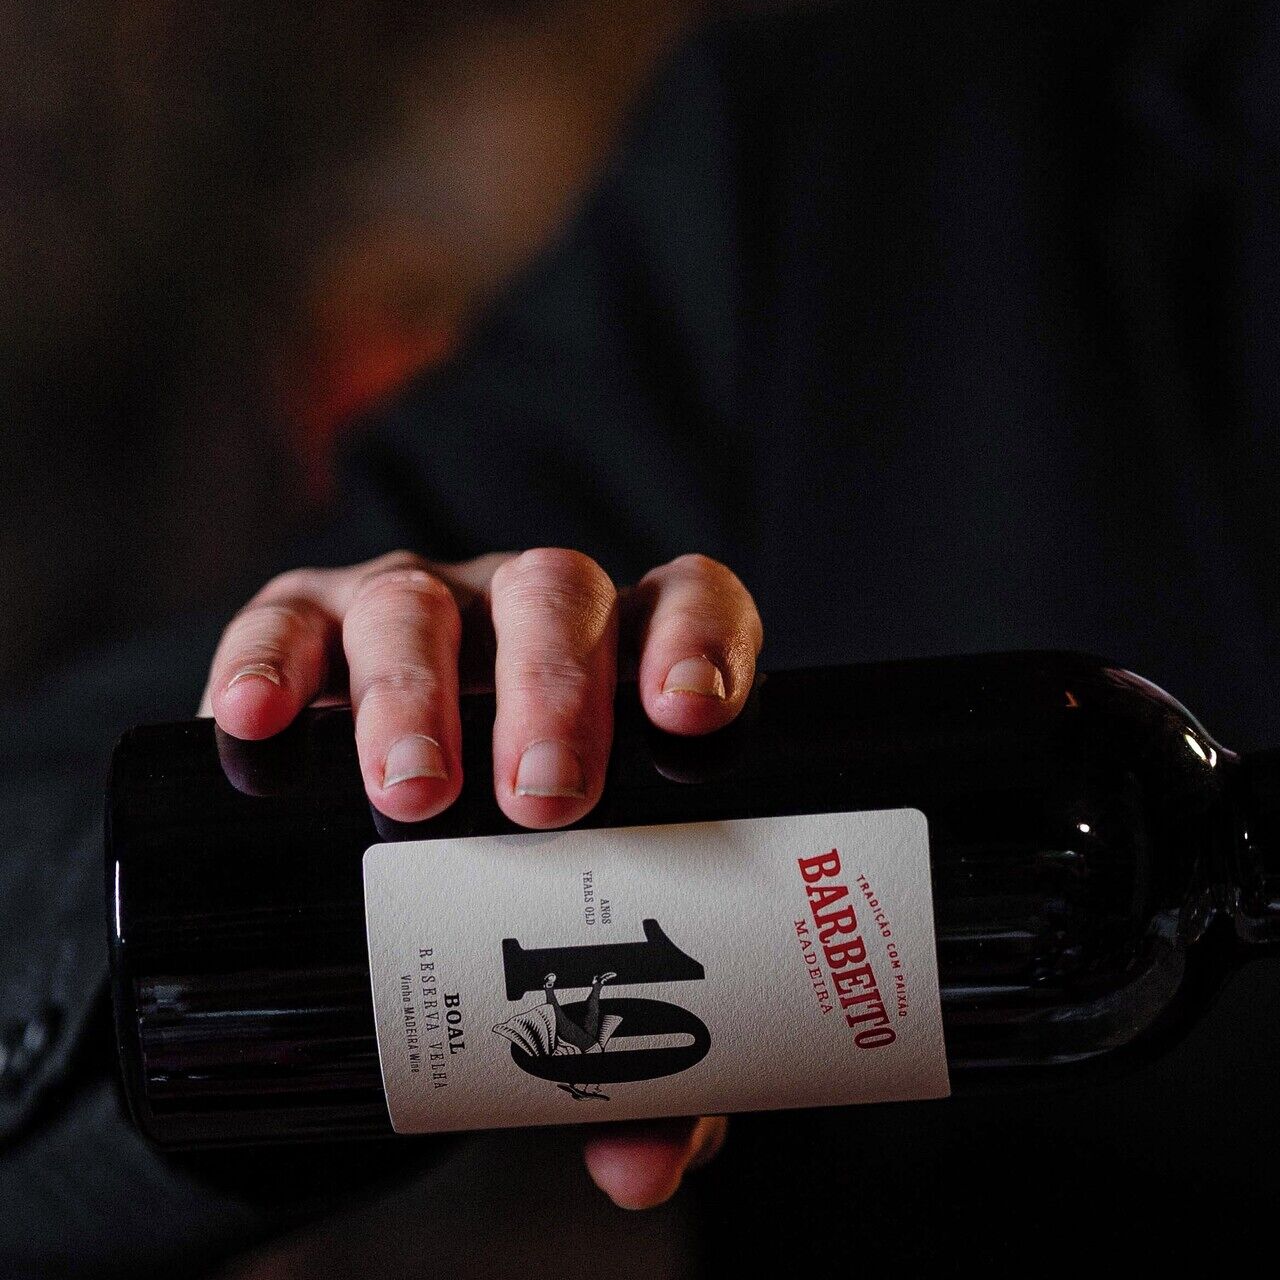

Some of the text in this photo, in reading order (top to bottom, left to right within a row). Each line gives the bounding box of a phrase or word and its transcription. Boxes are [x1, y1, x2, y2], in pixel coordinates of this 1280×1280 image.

[582, 870, 596, 926] YEARS OLD
[599, 898, 612, 925] ANOS
[856, 873, 909, 1018] TRADIÇÃO COM PAIXÃO
[793, 918, 834, 1016] MADEIRA
[798, 847, 898, 1050] BARBEITO
[400, 974, 422, 1073] Vinho MADEIRA Wine
[419, 948, 448, 1090] RESERVA VELHA
[444, 992, 466, 1055] BOAL
[501, 918, 712, 1085] 10
